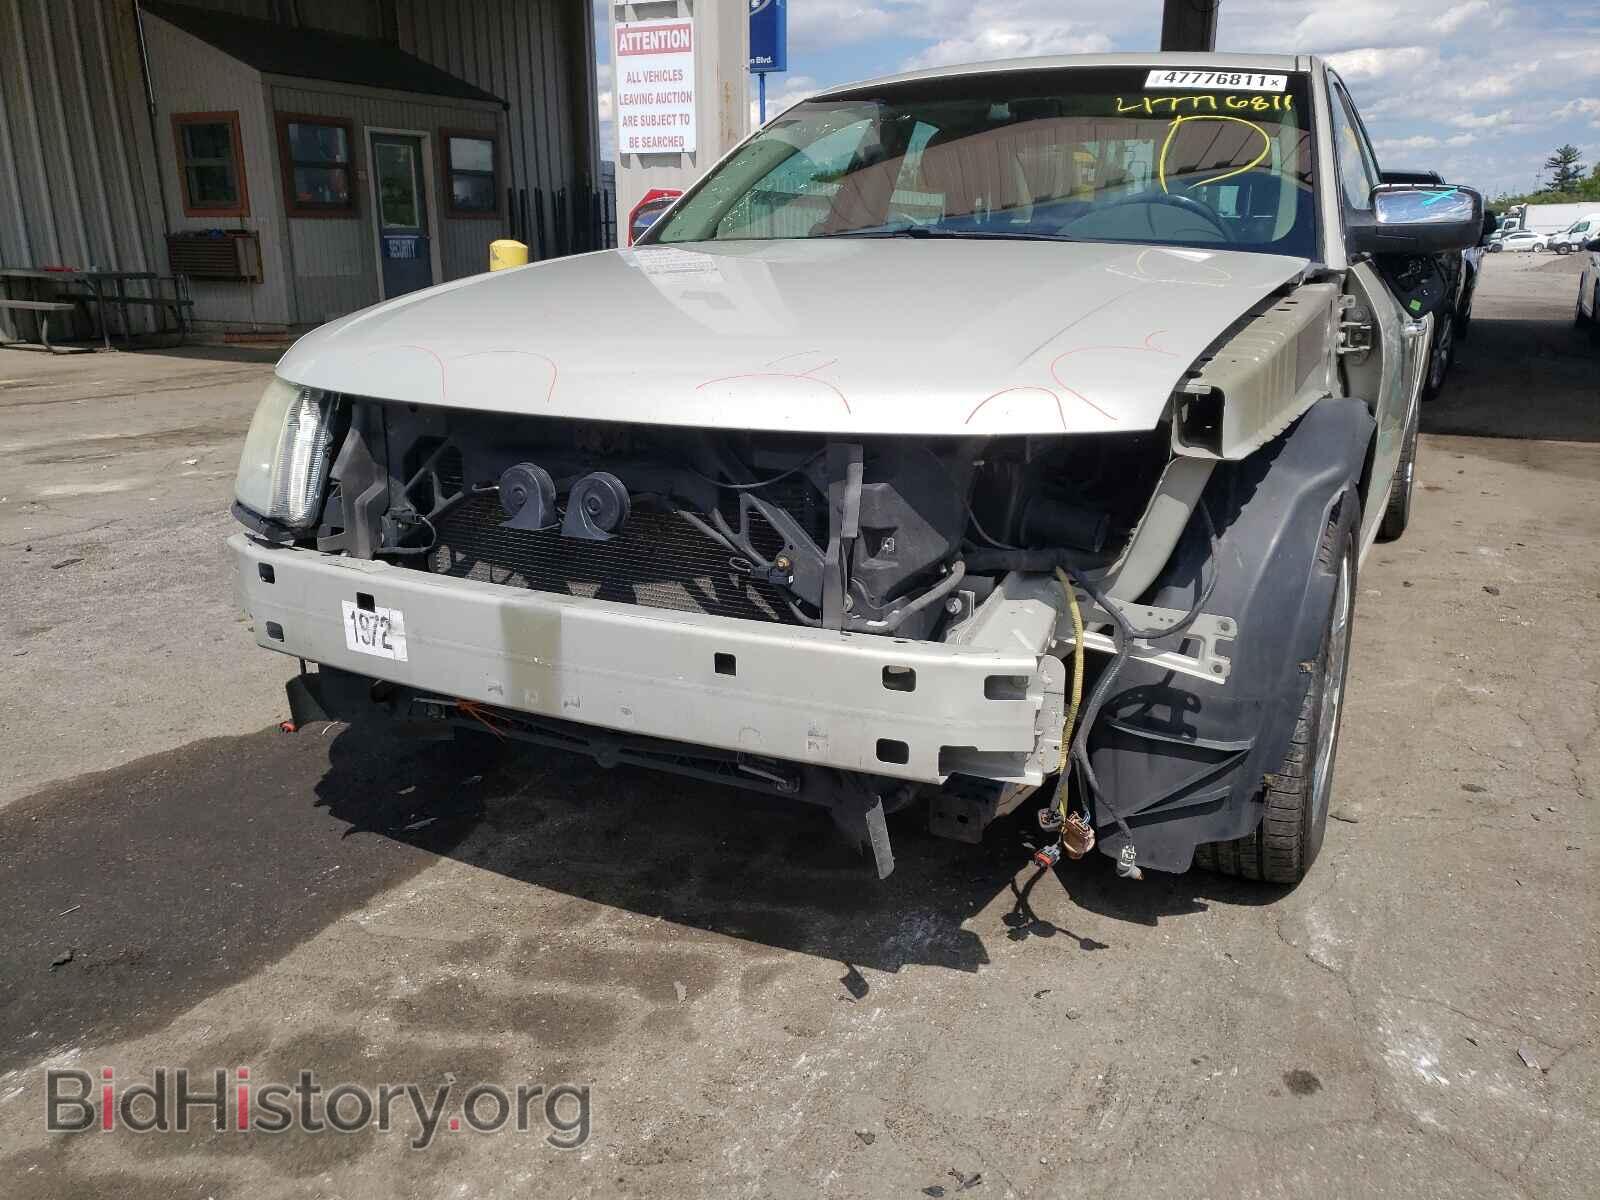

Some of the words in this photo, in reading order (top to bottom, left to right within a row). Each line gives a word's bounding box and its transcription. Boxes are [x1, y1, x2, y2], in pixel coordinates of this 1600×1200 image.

[619, 29, 690, 51] ATTENTION
[626, 71, 641, 83] ALL
[643, 69, 683, 82] VEHICLES
[1164, 71, 1266, 87] 47776811
[619, 92, 654, 106] LEAVING
[656, 91, 692, 104] AUCTION
[622, 115, 638, 127] ARE
[640, 114, 677, 127] SUBJECT
[679, 114, 690, 126] TO
[629, 136, 639, 148] BE
[641, 135, 685, 148] SEARCHED
[388, 240, 416, 258] SECURITY
[350, 610, 393, 650] 1972
